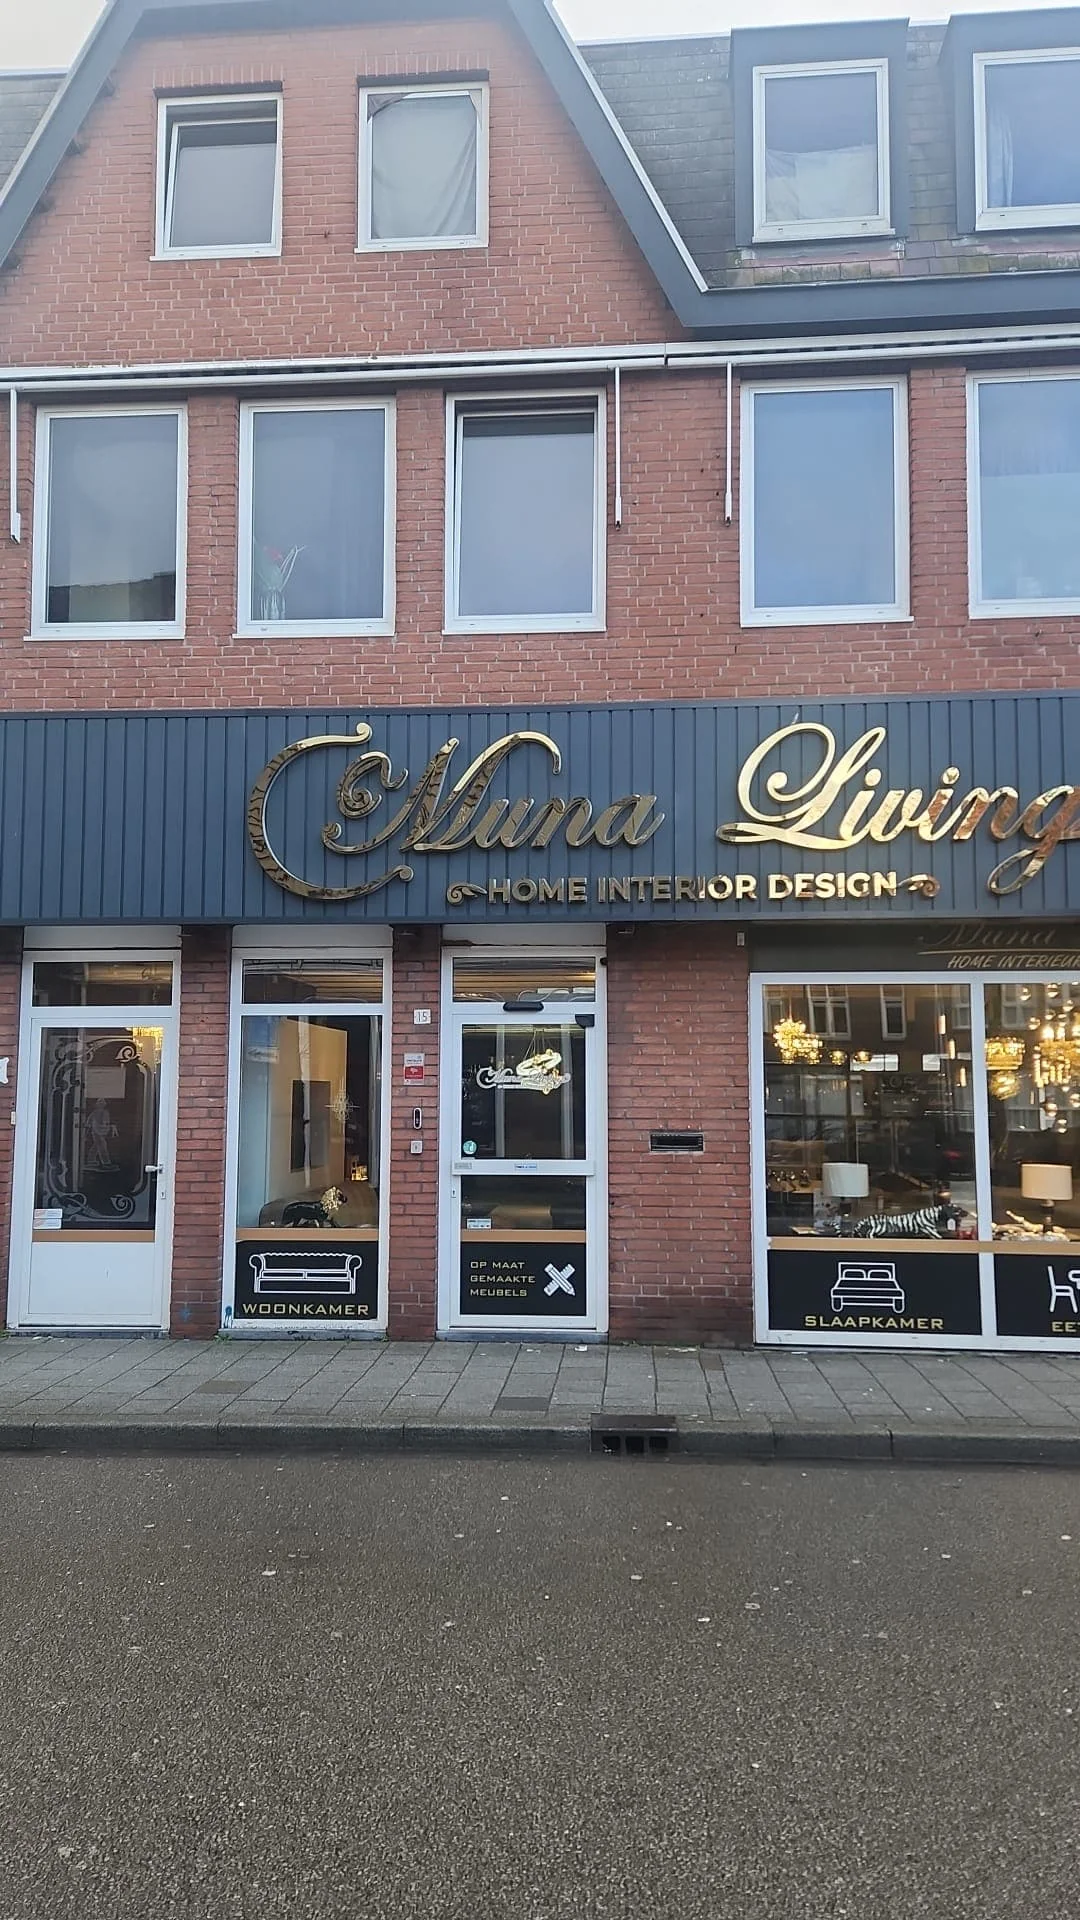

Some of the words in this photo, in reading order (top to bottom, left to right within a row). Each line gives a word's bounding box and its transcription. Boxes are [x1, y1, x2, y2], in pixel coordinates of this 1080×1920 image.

[716, 722, 1080, 895] Living
[488, 878, 587, 904] HOME
[598, 874, 757, 903] INTERIOR
[768, 871, 897, 899] DESIGN
[948, 955, 996, 969] HOME
[417, 1011, 428, 1022] 15
[470, 1261, 487, 1269] OP
[492, 1261, 525, 1269] MAAT
[470, 1275, 536, 1283] GEMAAKTE
[470, 1289, 527, 1297] MEUBELS
[242, 1303, 369, 1315] WOONKAMER
[804, 1316, 944, 1329] SLAAPKAMER
